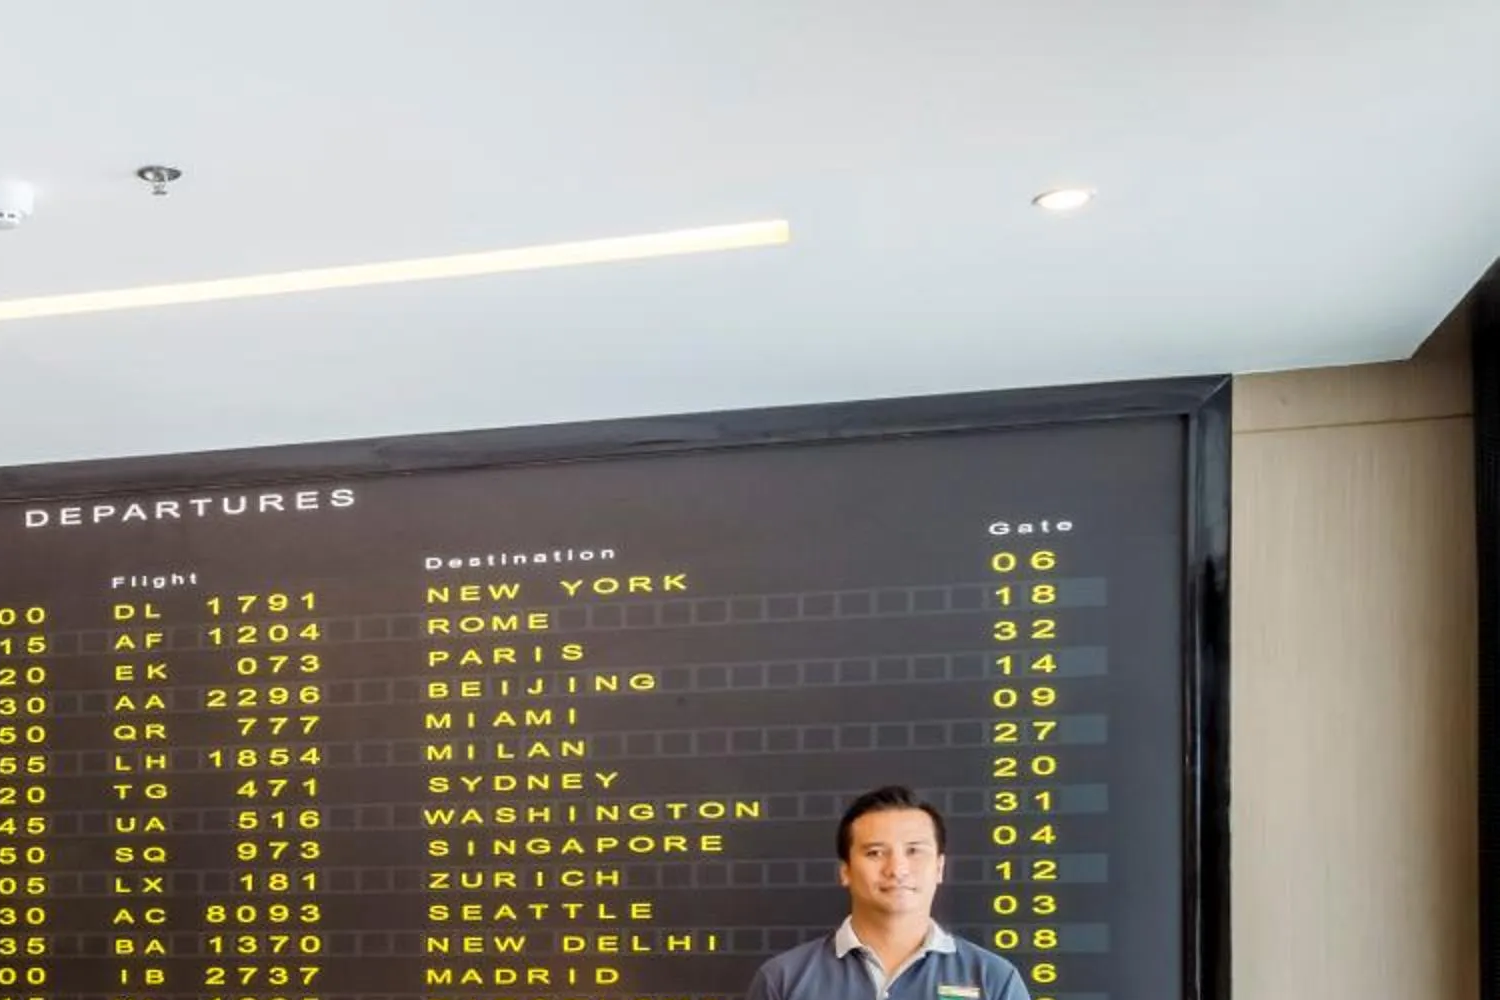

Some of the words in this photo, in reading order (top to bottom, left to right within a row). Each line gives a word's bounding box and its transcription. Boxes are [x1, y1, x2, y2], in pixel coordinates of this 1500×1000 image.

[25, 488, 355, 528] DEPARTURES
[111, 571, 198, 589] Flight
[424, 547, 616, 570] Destination
[988, 518, 1074, 536] Gate
[113, 603, 161, 621] DL
[206, 591, 316, 616] 1791
[425, 583, 520, 605] NEW
[560, 574, 685, 597] YORK
[989, 549, 1057, 573] 06
[115, 632, 162, 650] AF
[210, 621, 321, 646] 1204
[425, 612, 549, 634] ROME
[998, 583, 1057, 606] 18
[114, 663, 166, 682] EK
[236, 653, 322, 676] 073
[427, 642, 583, 667] PARIS
[995, 618, 1057, 642] 32
[113, 693, 166, 712] AA
[205, 684, 322, 709] 2296
[427, 672, 656, 700] BEIJING
[1000, 653, 1057, 676] 14
[112, 722, 167, 741] QR
[236, 714, 321, 737] 777
[424, 707, 578, 730] MIAMI
[991, 685, 1057, 709] 09
[115, 753, 167, 772] LH
[210, 746, 321, 769] 1854
[423, 739, 586, 762] MILAN
[995, 719, 1056, 744] 27
[115, 783, 168, 800] TG
[236, 777, 317, 799] 471
[427, 772, 617, 794] SYDNEY
[994, 754, 1058, 778] 20
[115, 816, 166, 833] UA
[237, 809, 321, 830] 516
[423, 800, 760, 828] WASHINGTON
[995, 790, 1051, 814] 31
[115, 846, 167, 863] SQ
[236, 840, 321, 861] 973
[427, 834, 723, 857] SINGAPORE
[991, 823, 1057, 846] 04
[115, 877, 164, 894] LX
[239, 872, 316, 892] 181
[428, 869, 620, 890] ZURICH
[996, 858, 1057, 882] 12
[113, 907, 166, 925] AC
[205, 903, 321, 924] 8093
[427, 902, 652, 921] SEATTLE
[992, 894, 1058, 916] 03
[115, 938, 166, 955] BA
[209, 935, 322, 955] 1370
[426, 935, 527, 954] NEW
[562, 934, 717, 954] DELHI
[993, 927, 1058, 950] 08
[120, 968, 165, 985] IB
[204, 966, 320, 986] 2737
[425, 967, 620, 985] MADRID
[1030, 962, 1058, 984] 6
